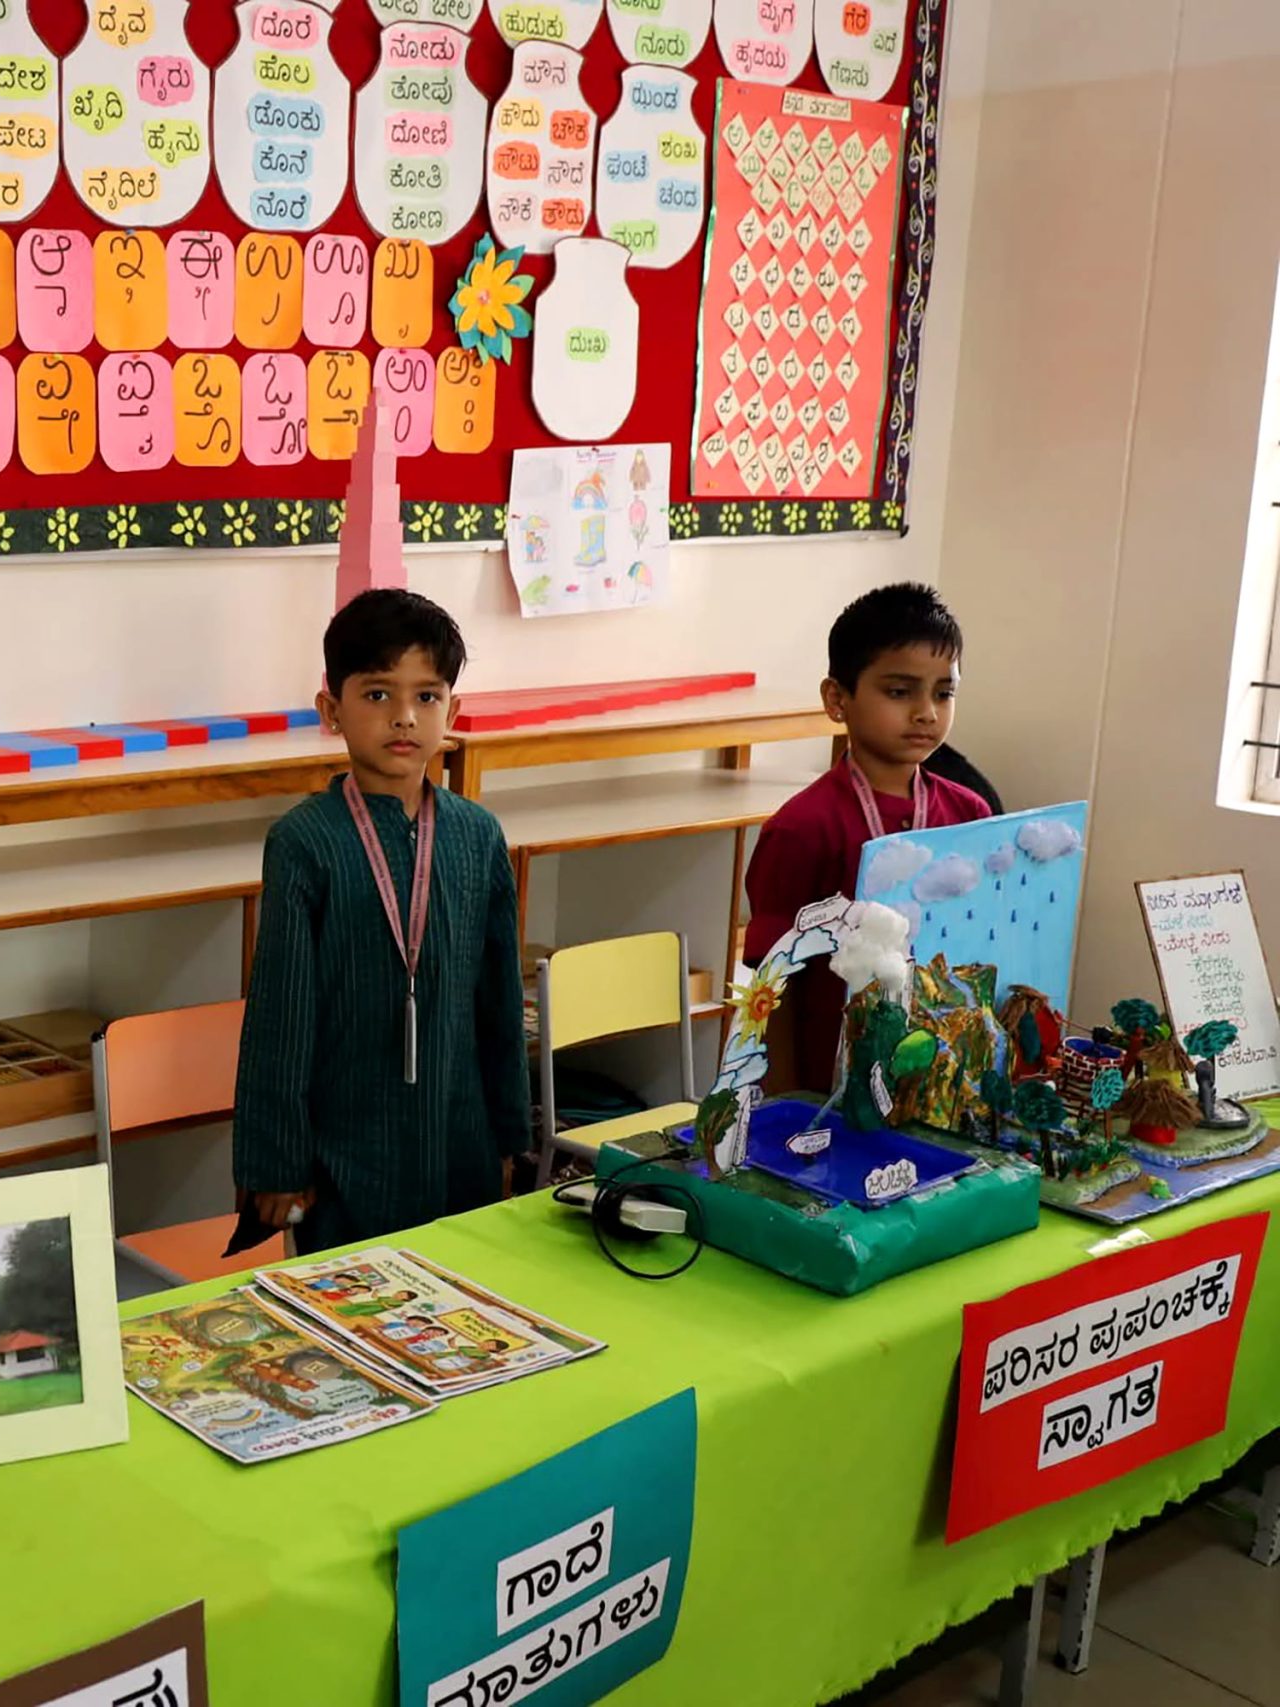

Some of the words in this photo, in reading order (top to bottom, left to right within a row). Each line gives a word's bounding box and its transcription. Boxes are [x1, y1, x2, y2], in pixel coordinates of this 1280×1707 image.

[98, 5, 146, 45] ದೈವ
[261, 11, 311, 40] ದೊರೆ
[505, 9, 563, 38] ಹುಡುಕು
[760, 2, 795, 33] ಮೃಗ
[390, 33, 455, 60] ನೋಡು
[641, 32, 685, 56] ನೂರು
[736, 41, 786, 73] ಹೃದಯ
[140, 62, 190, 100] ಗೈರು
[260, 55, 310, 84] ಹೊಲ
[524, 60, 566, 84] ಮೌನ
[391, 75, 452, 105] ತೋಪು
[73, 90, 123, 130] ಖೈದಿ
[254, 100, 320, 132] ಡೊಂಕು
[148, 124, 200, 163] ಹೈನು
[391, 119, 447, 145] ದೋಣಿ
[260, 145, 307, 174] ಕೊನೆ
[88, 171, 157, 210] ನೈದಿಲೆ
[389, 163, 442, 188] ಕೋತಿ
[257, 191, 307, 220] ನೊರೆ
[392, 206, 442, 230] ಕೋಣ
[799, 219, 812, 244] ಗ
[30, 233, 71, 276] ಆ
[110, 235, 145, 279] ಇ
[180, 233, 222, 280] ಈ
[246, 241, 292, 280] ಉ
[313, 240, 364, 275] ಊ
[384, 242, 420, 279] ಋ
[36, 357, 72, 401] ಏ
[118, 360, 155, 401] ಐ
[193, 358, 222, 399] ಒ
[262, 356, 292, 405] ಓ
[325, 351, 354, 400] ಔ
[386, 356, 426, 393] ಅಂ
[984, 1324, 1080, 1399] ಪರಿಸರ
[1089, 1260, 1230, 1359] ಪ್ರಪಂಚಕ್ಕೆ
[1043, 1365, 1159, 1455] ಸ್ವಾಗತ
[506, 1521, 604, 1617] ಗಾದೆ
